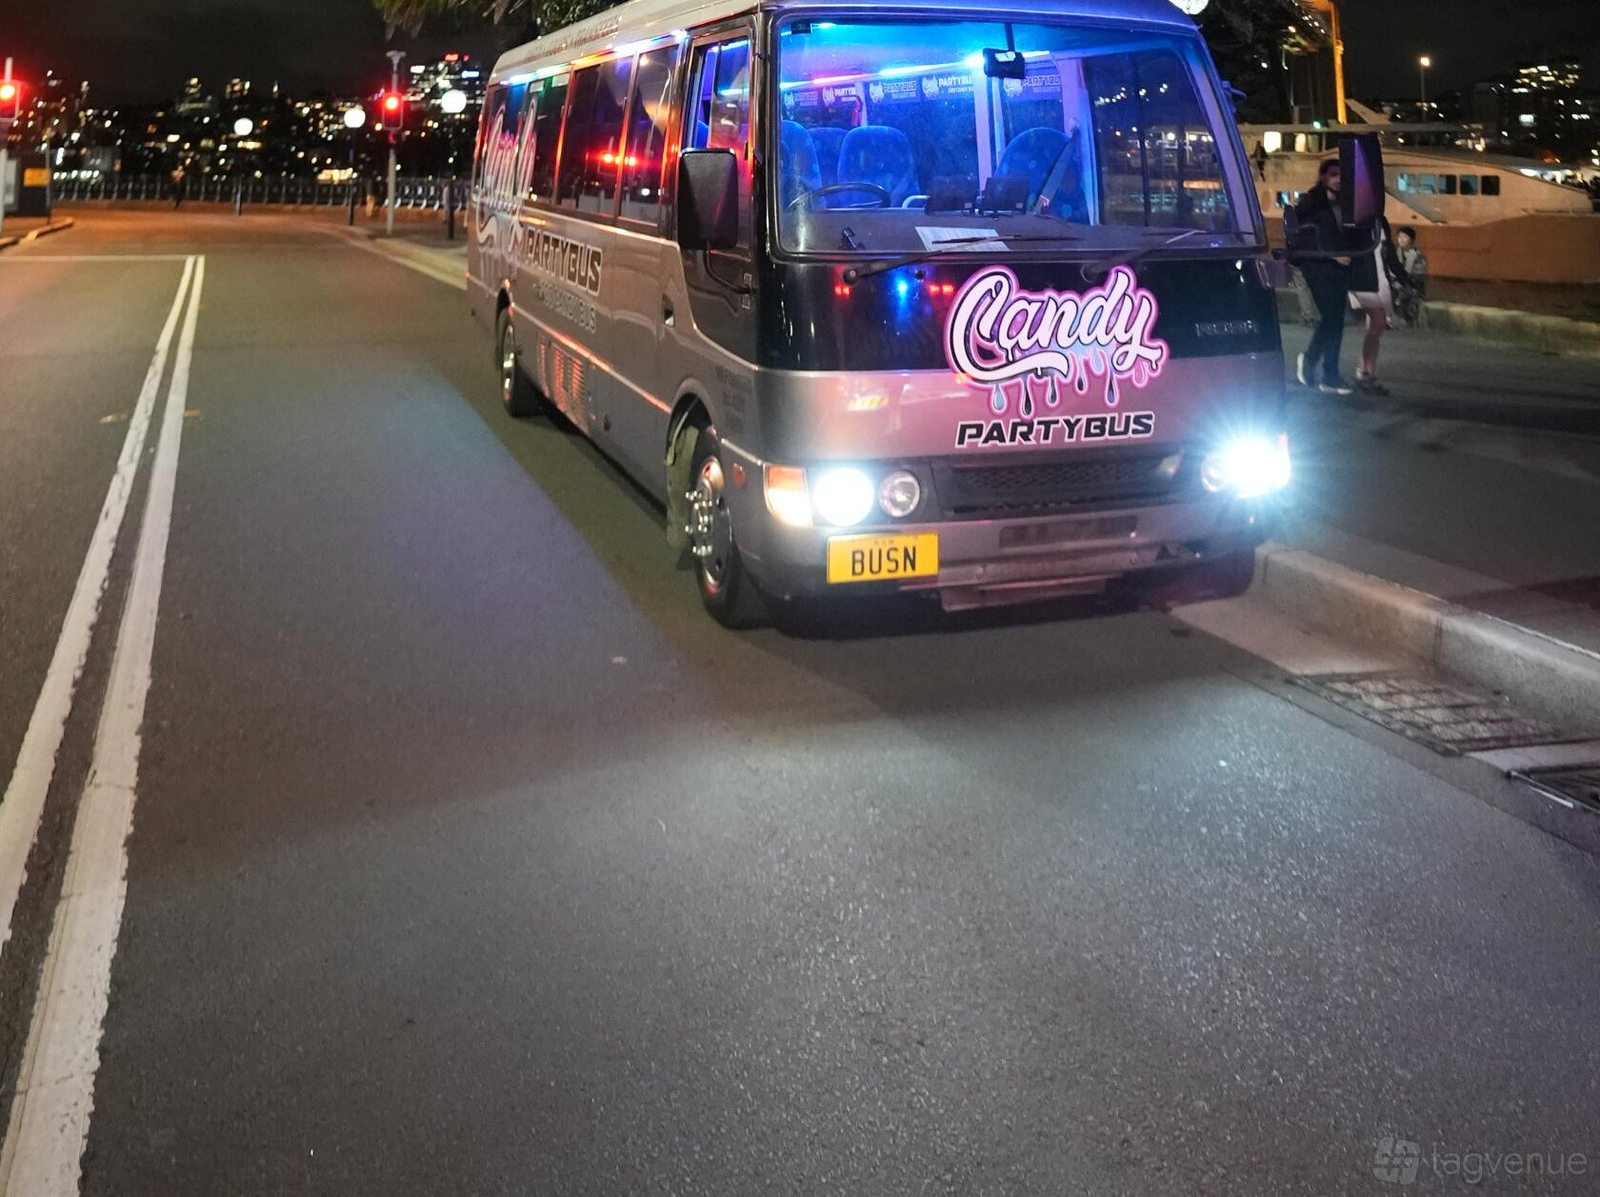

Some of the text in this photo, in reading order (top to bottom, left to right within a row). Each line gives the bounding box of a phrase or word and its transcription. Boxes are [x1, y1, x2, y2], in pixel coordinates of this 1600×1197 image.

[939, 75, 972, 86] PARTYBU
[1024, 74, 1060, 87] PARTYBU
[527, 226, 602, 297] PARTYBUS
[948, 267, 1165, 383] Candy
[955, 411, 1155, 448] PARTYBUS
[851, 545, 916, 577] BUSN
